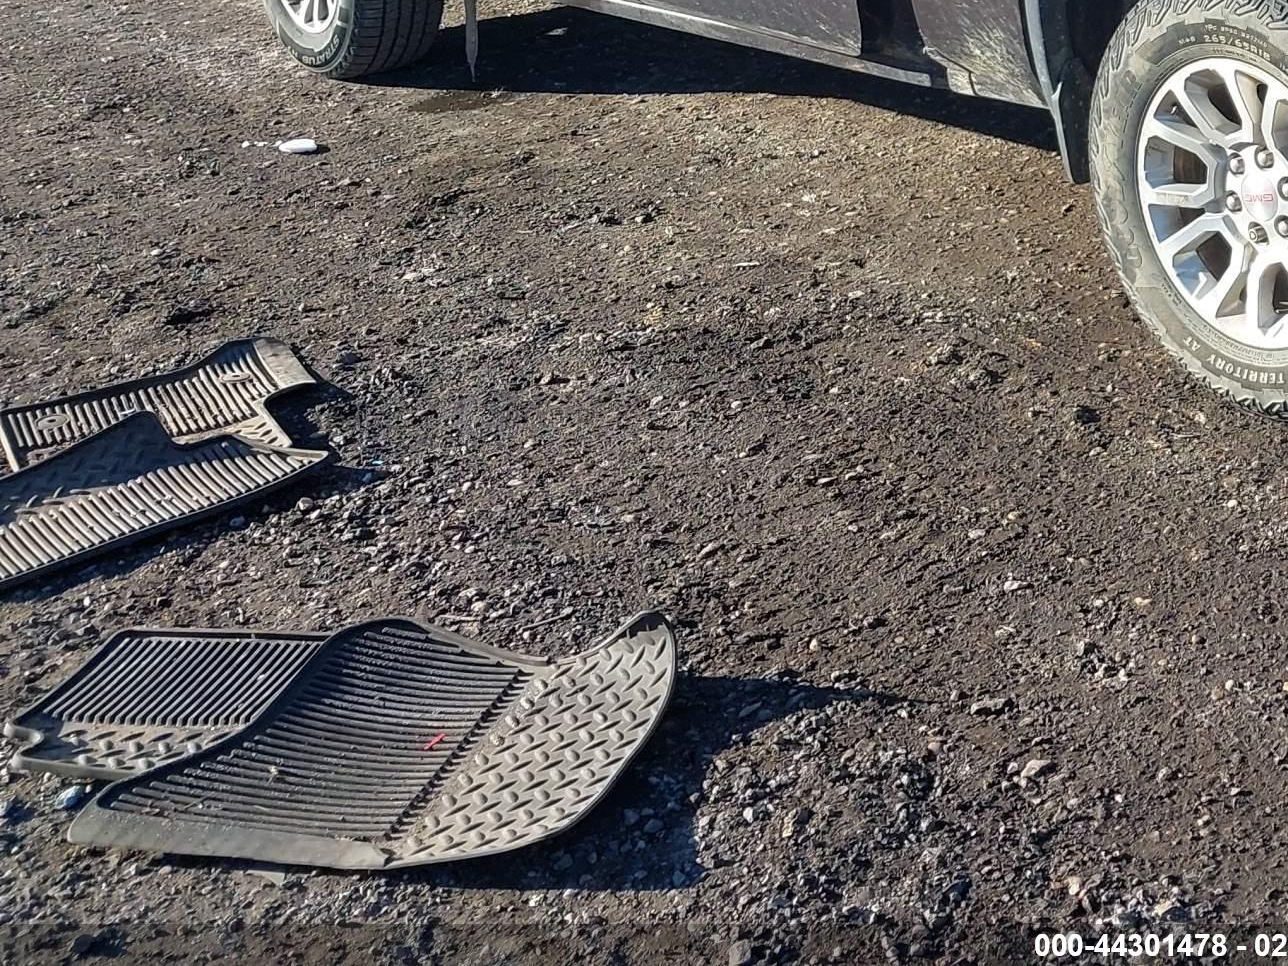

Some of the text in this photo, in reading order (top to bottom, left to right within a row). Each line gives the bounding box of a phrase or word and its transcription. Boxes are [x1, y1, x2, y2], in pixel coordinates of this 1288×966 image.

[301, 33, 340, 66] STRATUS
[1203, 34, 1271, 61] 265/65R18
[1244, 193, 1274, 203] GMC
[1181, 335, 1202, 351] AT
[1205, 353, 1285, 385] TERRITORY
